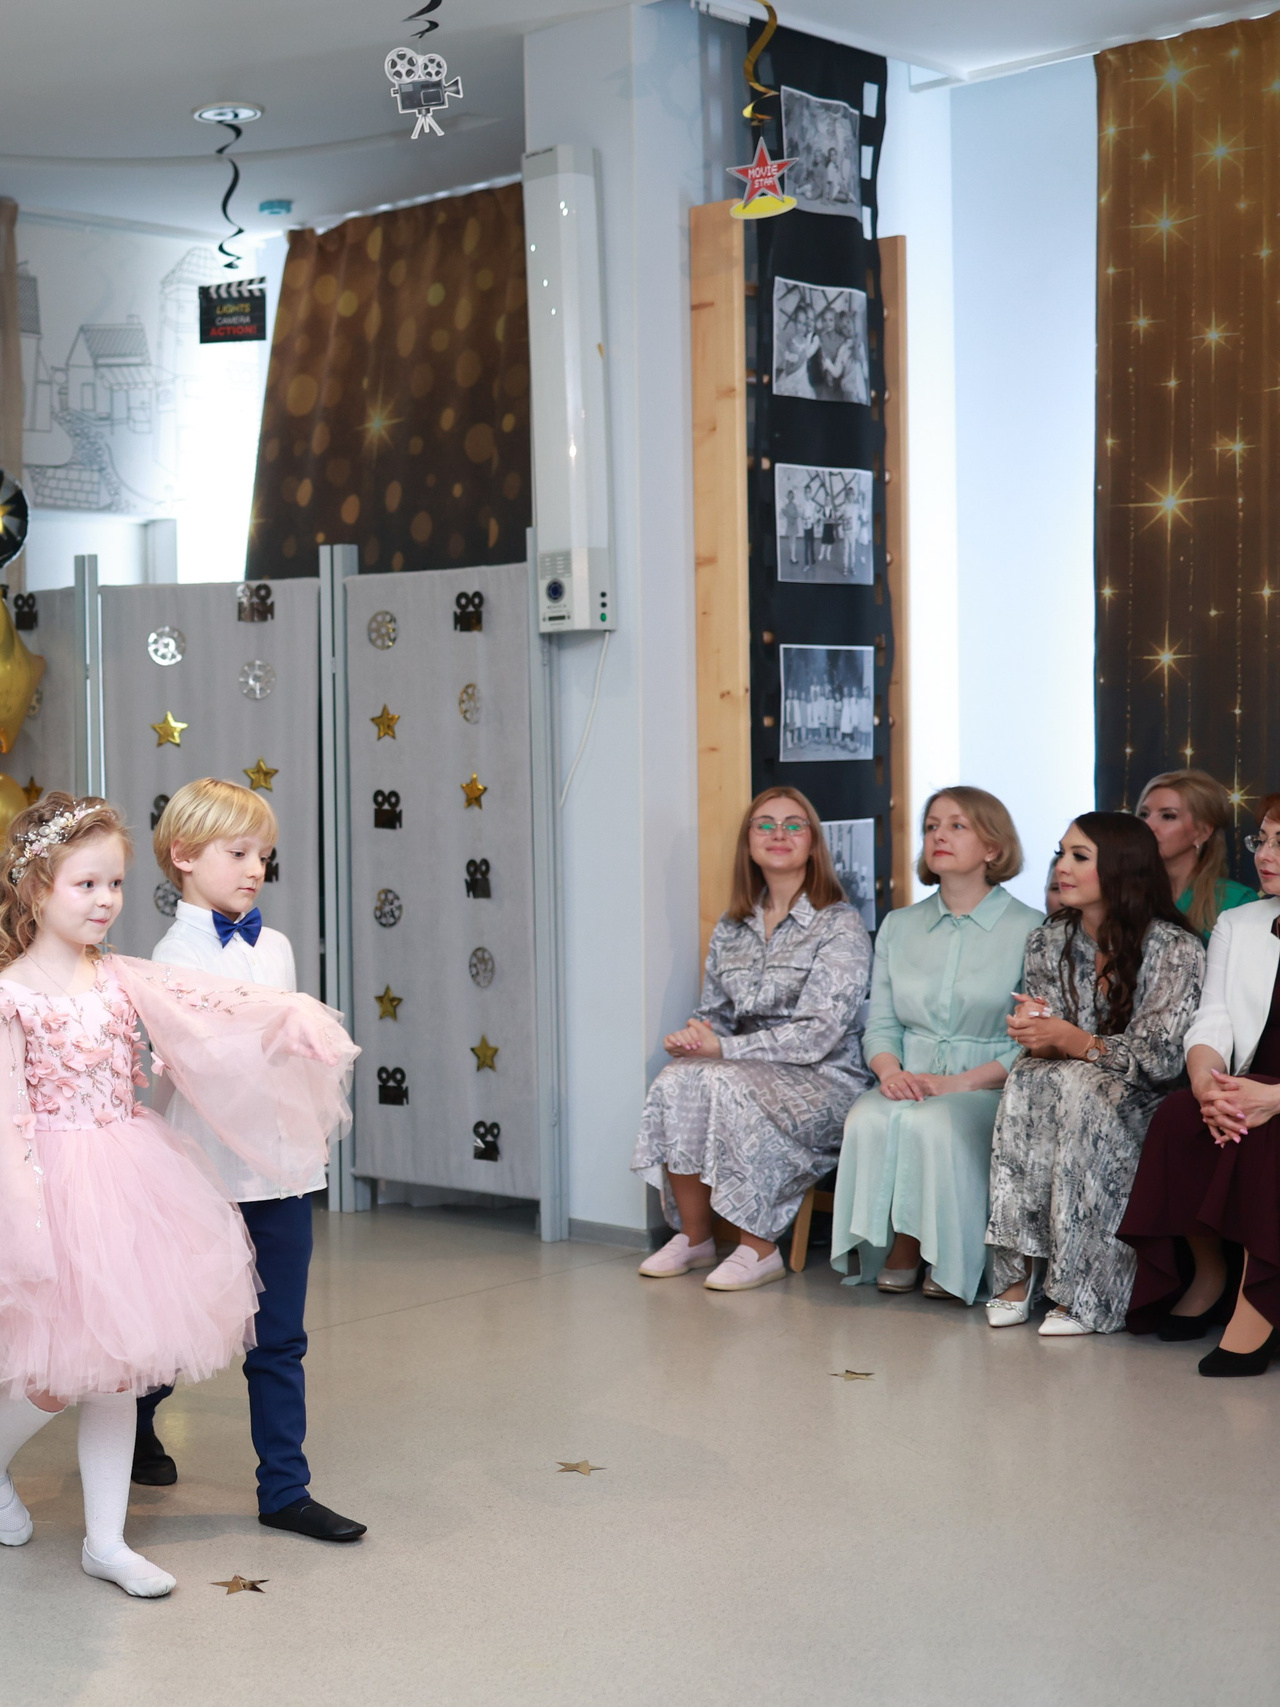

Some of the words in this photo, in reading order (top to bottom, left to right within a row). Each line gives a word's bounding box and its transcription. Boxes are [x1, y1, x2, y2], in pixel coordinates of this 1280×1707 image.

[748, 165, 778, 178] MOVIE
[754, 178, 774, 188] STAR
[216, 303, 251, 315] LIGHTS
[215, 315, 251, 326] CAMERA
